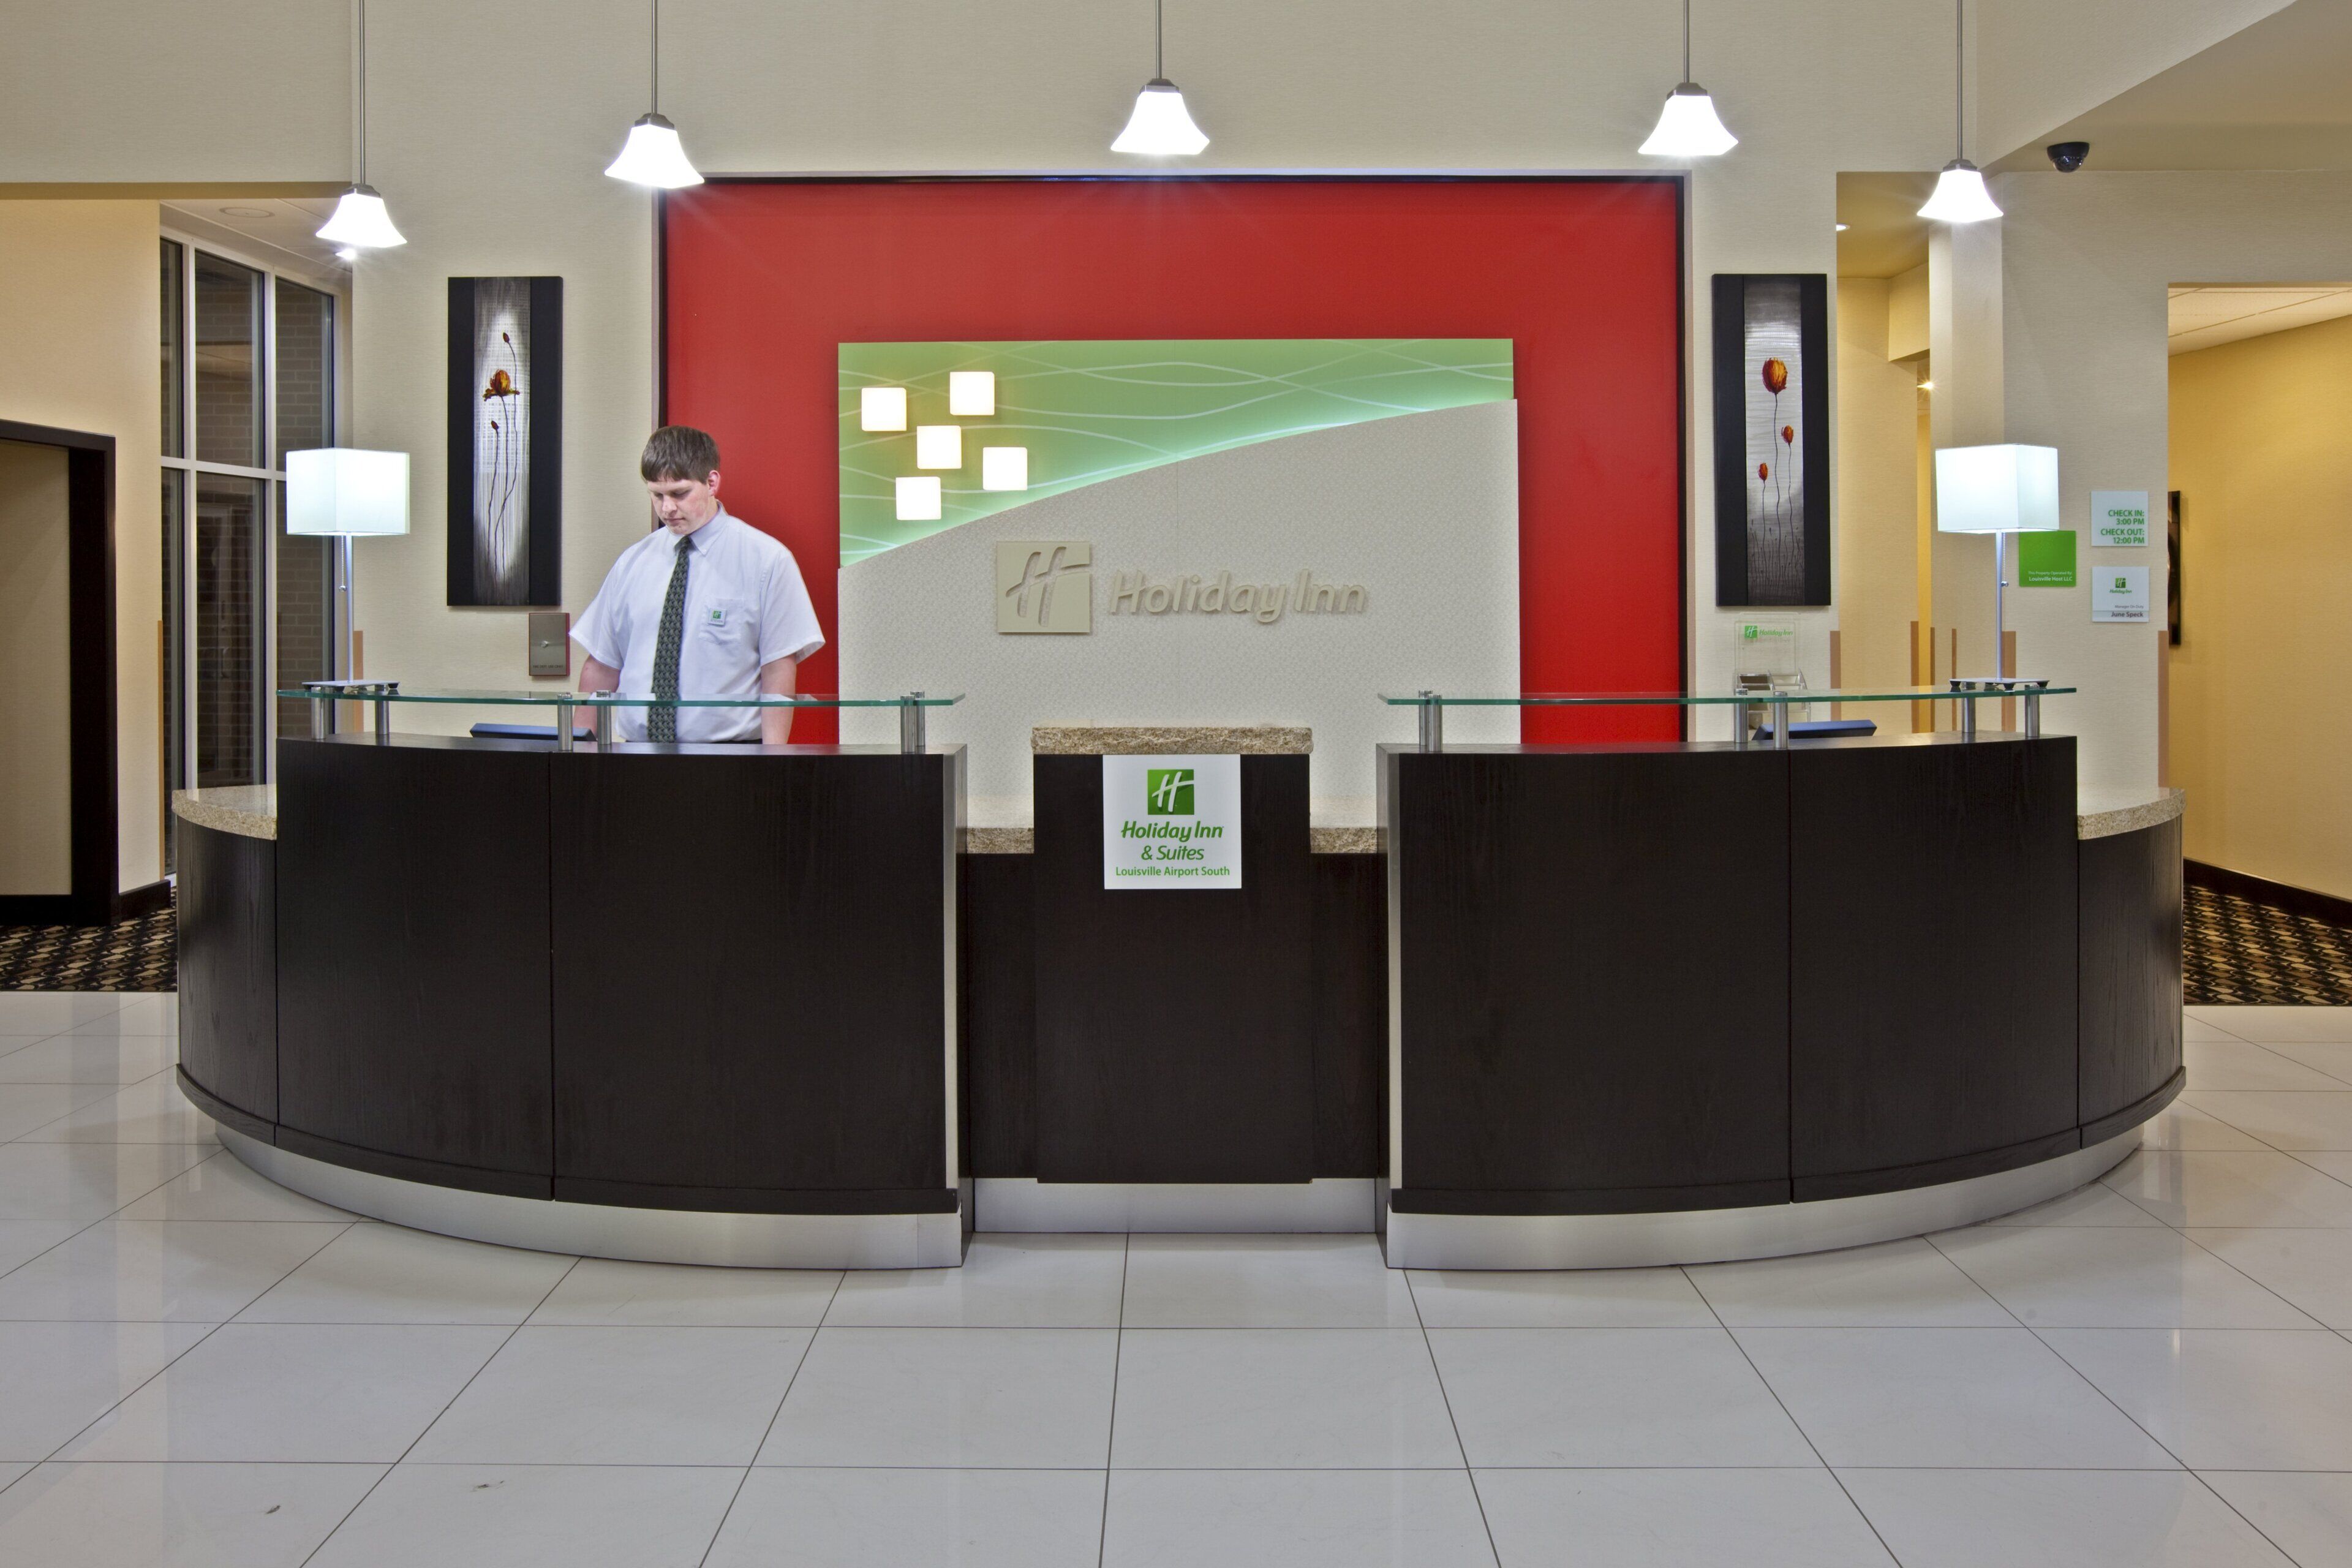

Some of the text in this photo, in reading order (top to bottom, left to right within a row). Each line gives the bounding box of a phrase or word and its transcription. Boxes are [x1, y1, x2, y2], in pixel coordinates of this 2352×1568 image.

[1109, 568, 1368, 624] Holiday Inn
[1121, 821, 1224, 843] Holiday Inn
[1141, 845, 1205, 861] & Suites
[1116, 866, 1230, 878] Louisville Airport South
